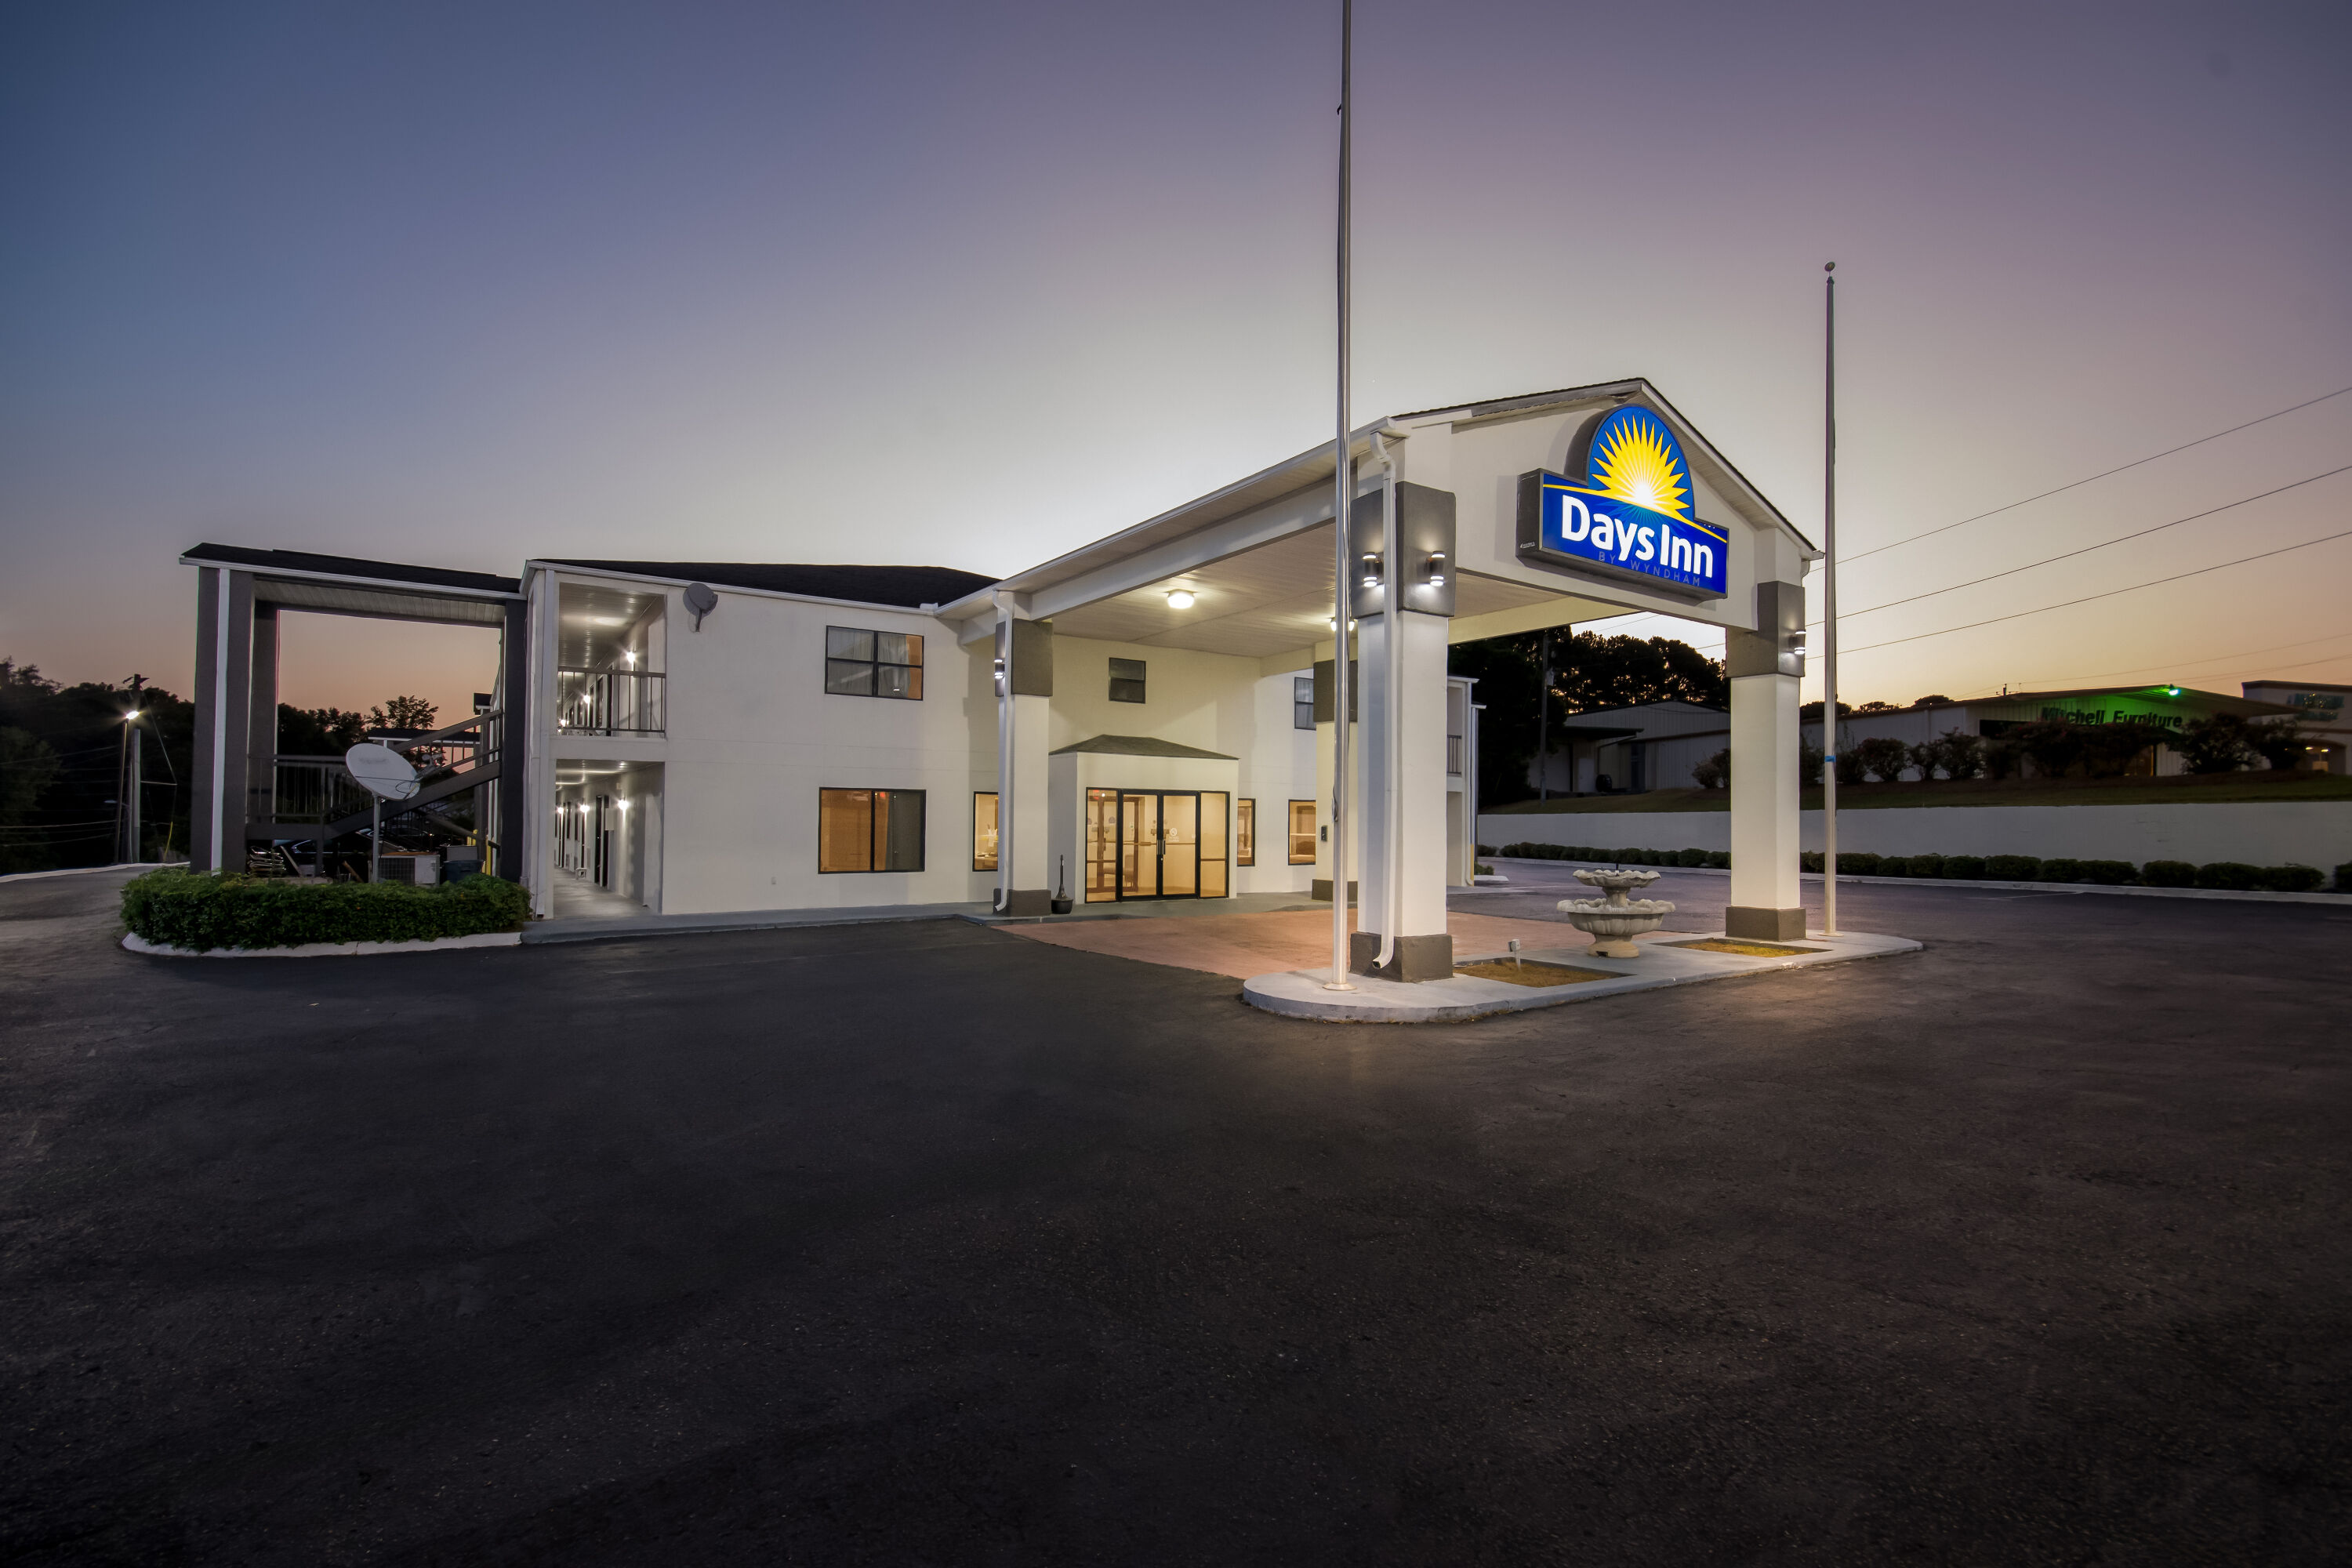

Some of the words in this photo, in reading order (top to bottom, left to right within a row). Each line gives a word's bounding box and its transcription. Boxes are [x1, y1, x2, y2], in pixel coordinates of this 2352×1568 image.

[1562, 494, 1655, 562] Days
[1659, 524, 1714, 579] Inn
[1599, 550, 1616, 564] BY
[1630, 559, 1700, 587] WYNDHAM
[2042, 707, 2106, 725] Mitchell
[2113, 710, 2183, 728] Furniture
